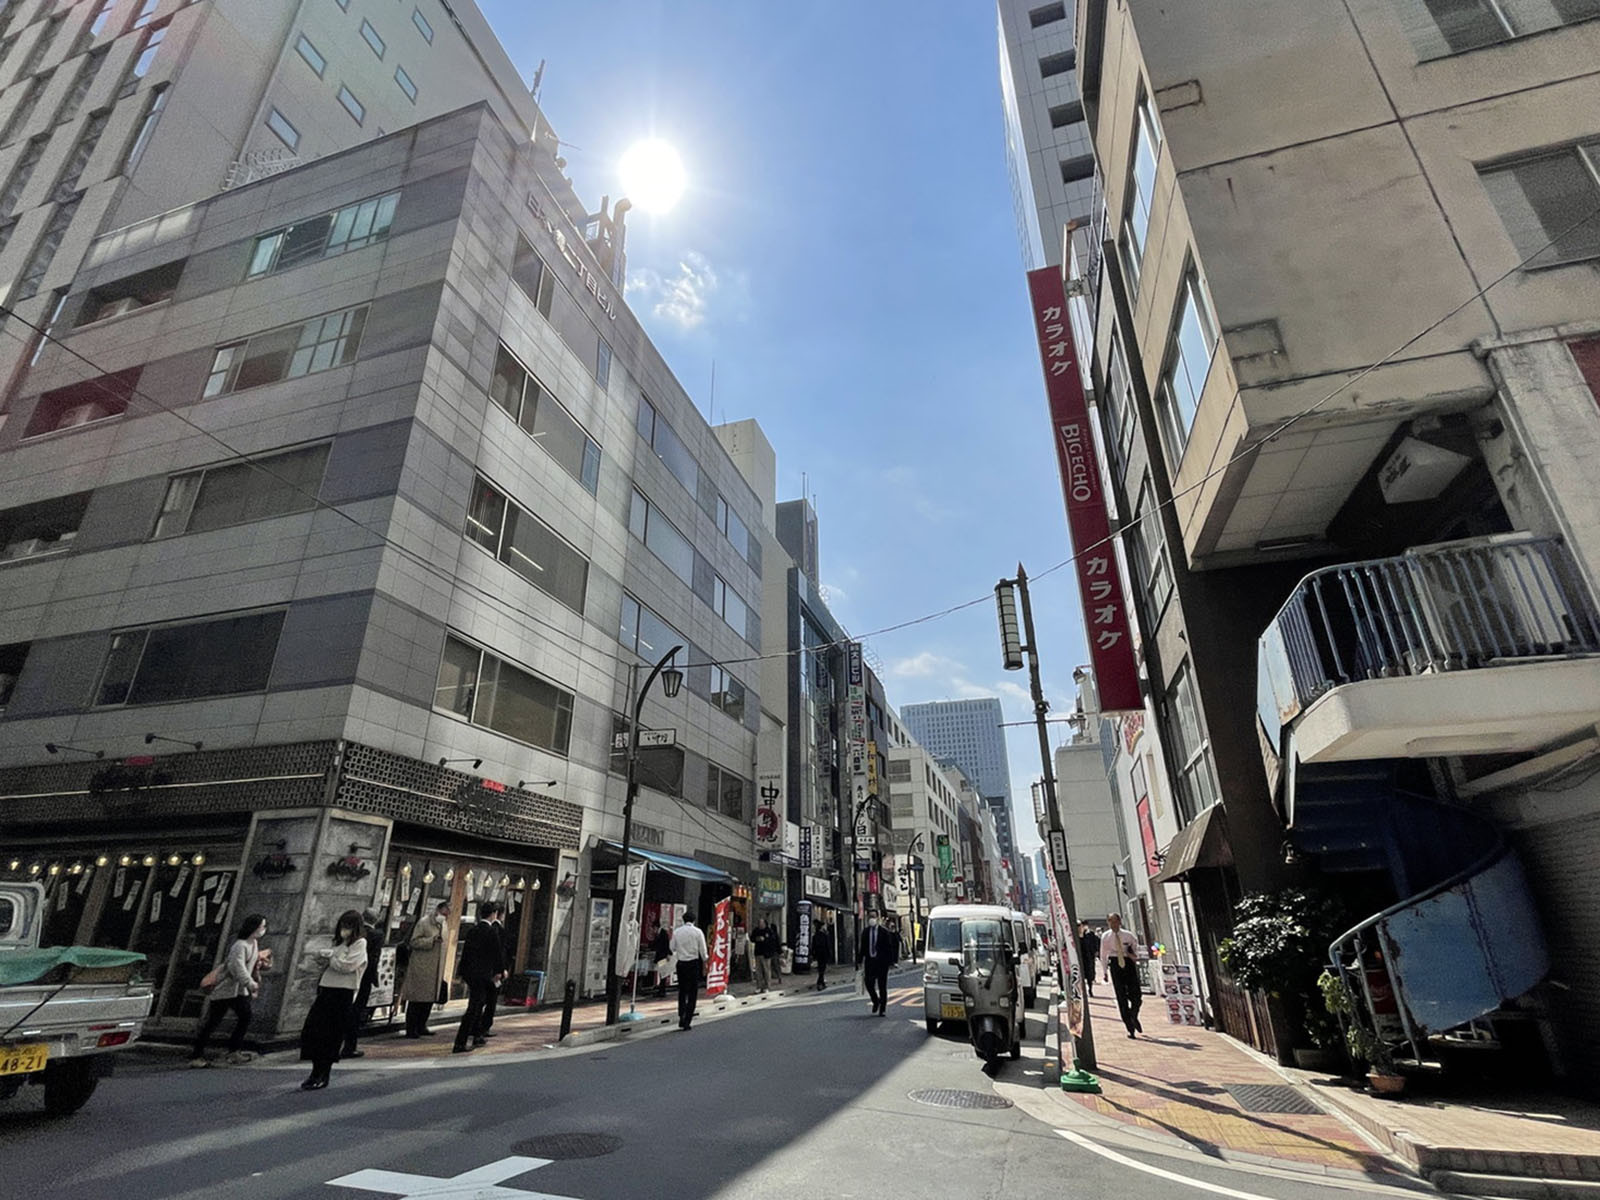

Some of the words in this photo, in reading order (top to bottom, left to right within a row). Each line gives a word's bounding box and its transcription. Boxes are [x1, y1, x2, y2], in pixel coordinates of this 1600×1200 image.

[1042, 306, 1073, 377] カラオケ
[1061, 424, 1083, 455] BIG
[1071, 456, 1091, 502] ECHO
[1086, 556, 1122, 650] カラオケ
[1, 1056, 42, 1073] 48-21
